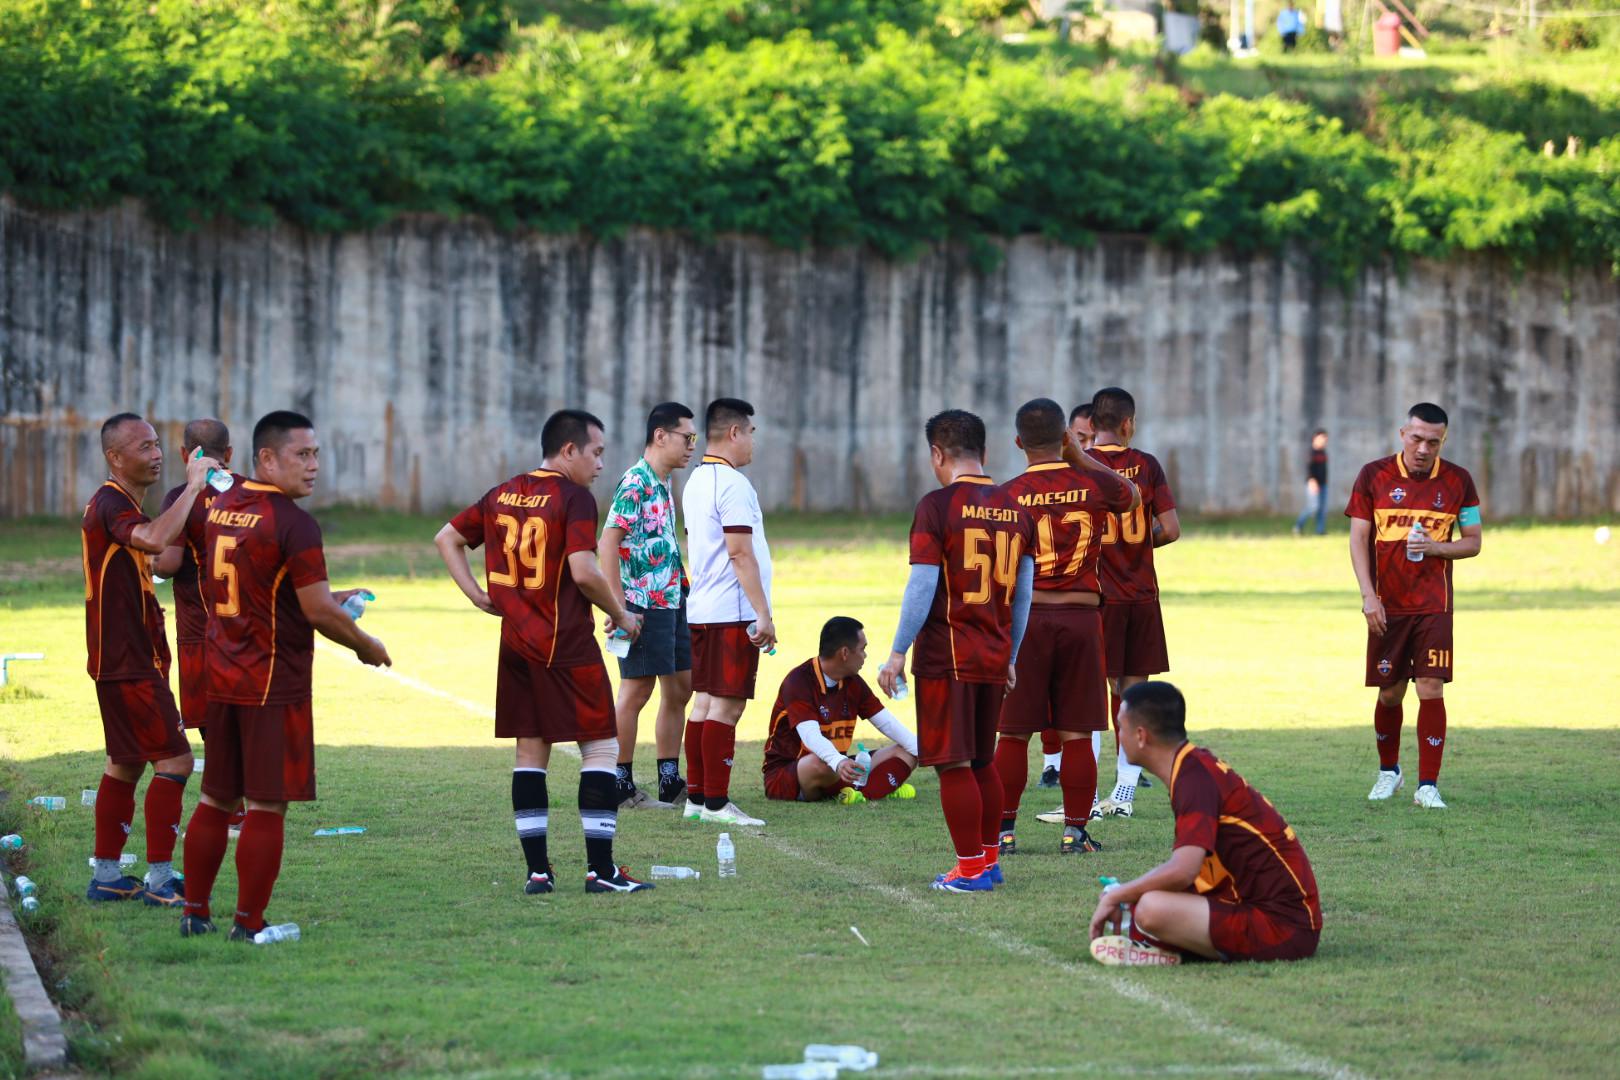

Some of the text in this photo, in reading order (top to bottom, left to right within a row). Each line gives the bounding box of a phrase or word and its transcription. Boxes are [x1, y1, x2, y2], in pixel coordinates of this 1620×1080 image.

[497, 492, 551, 508] MAESOT
[1017, 489, 1090, 507] MAESOT
[208, 508, 263, 528] MAESOT
[962, 505, 1019, 523] MAESOT
[1386, 515, 1444, 530] POLICE
[489, 513, 548, 590] 39
[213, 535, 240, 617] 5
[962, 528, 1021, 606] 54
[1427, 649, 1449, 668] 511
[1095, 945, 1178, 965] PREDATOR
